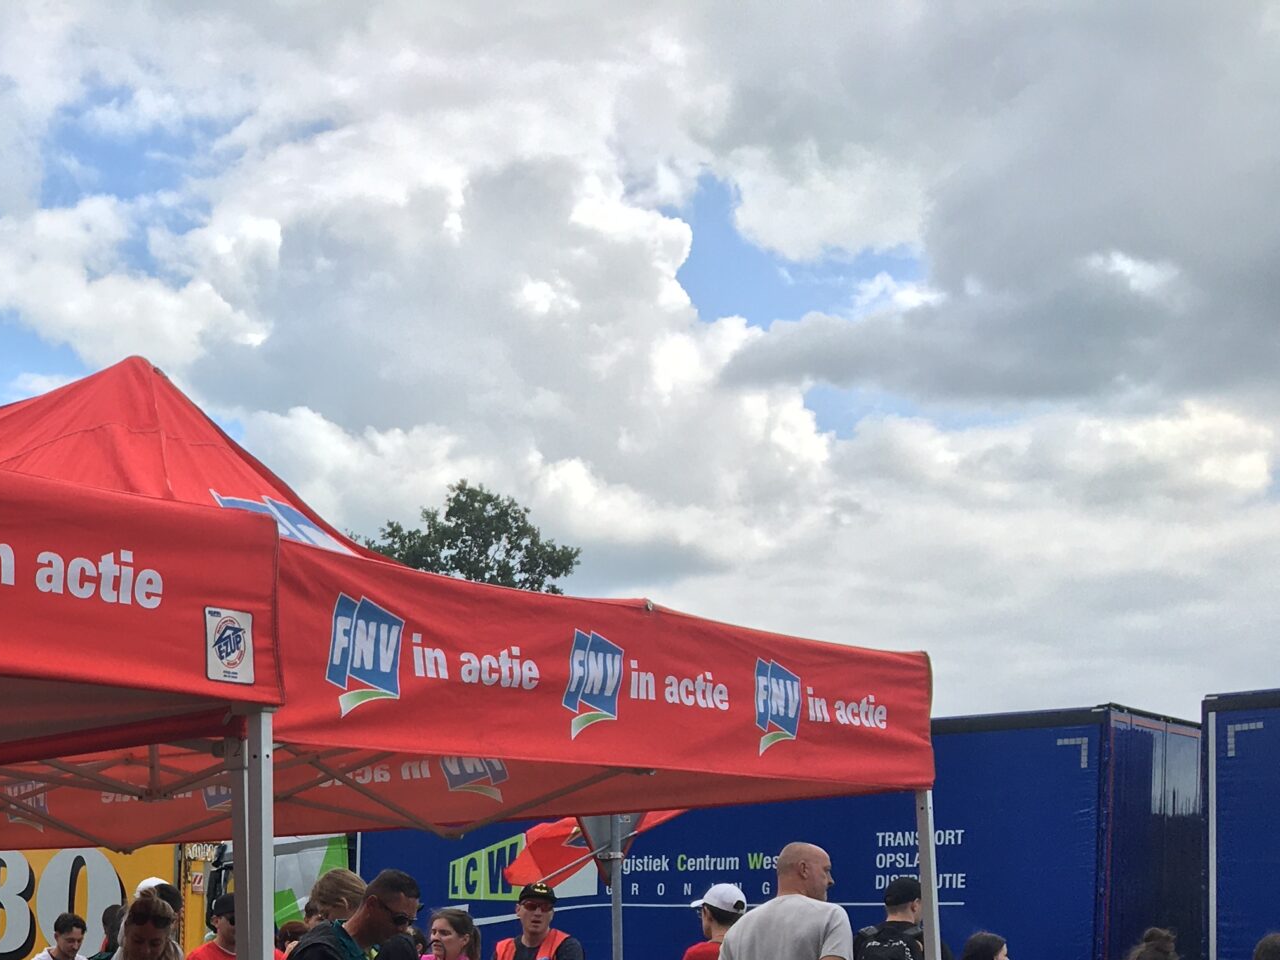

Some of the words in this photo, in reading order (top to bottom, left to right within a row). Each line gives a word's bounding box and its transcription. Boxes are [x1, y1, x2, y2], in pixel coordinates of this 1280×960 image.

[35, 550, 163, 609] actie
[332, 616, 401, 673] FNV
[412, 632, 449, 680] in
[460, 646, 540, 690] actie
[570, 649, 621, 697] FNV
[630, 660, 656, 700] in
[665, 672, 729, 710] actie
[756, 675, 800, 719] FNV
[807, 688, 830, 723] in
[834, 695, 887, 729] actie
[621, 854, 669, 875] gistiek
[677, 853, 739, 871] Centrum
[747, 852, 779, 870] Wes
[875, 852, 920, 868] OPSLA
[876, 829, 964, 847] TRANORT
[451, 843, 517, 895] LCW
